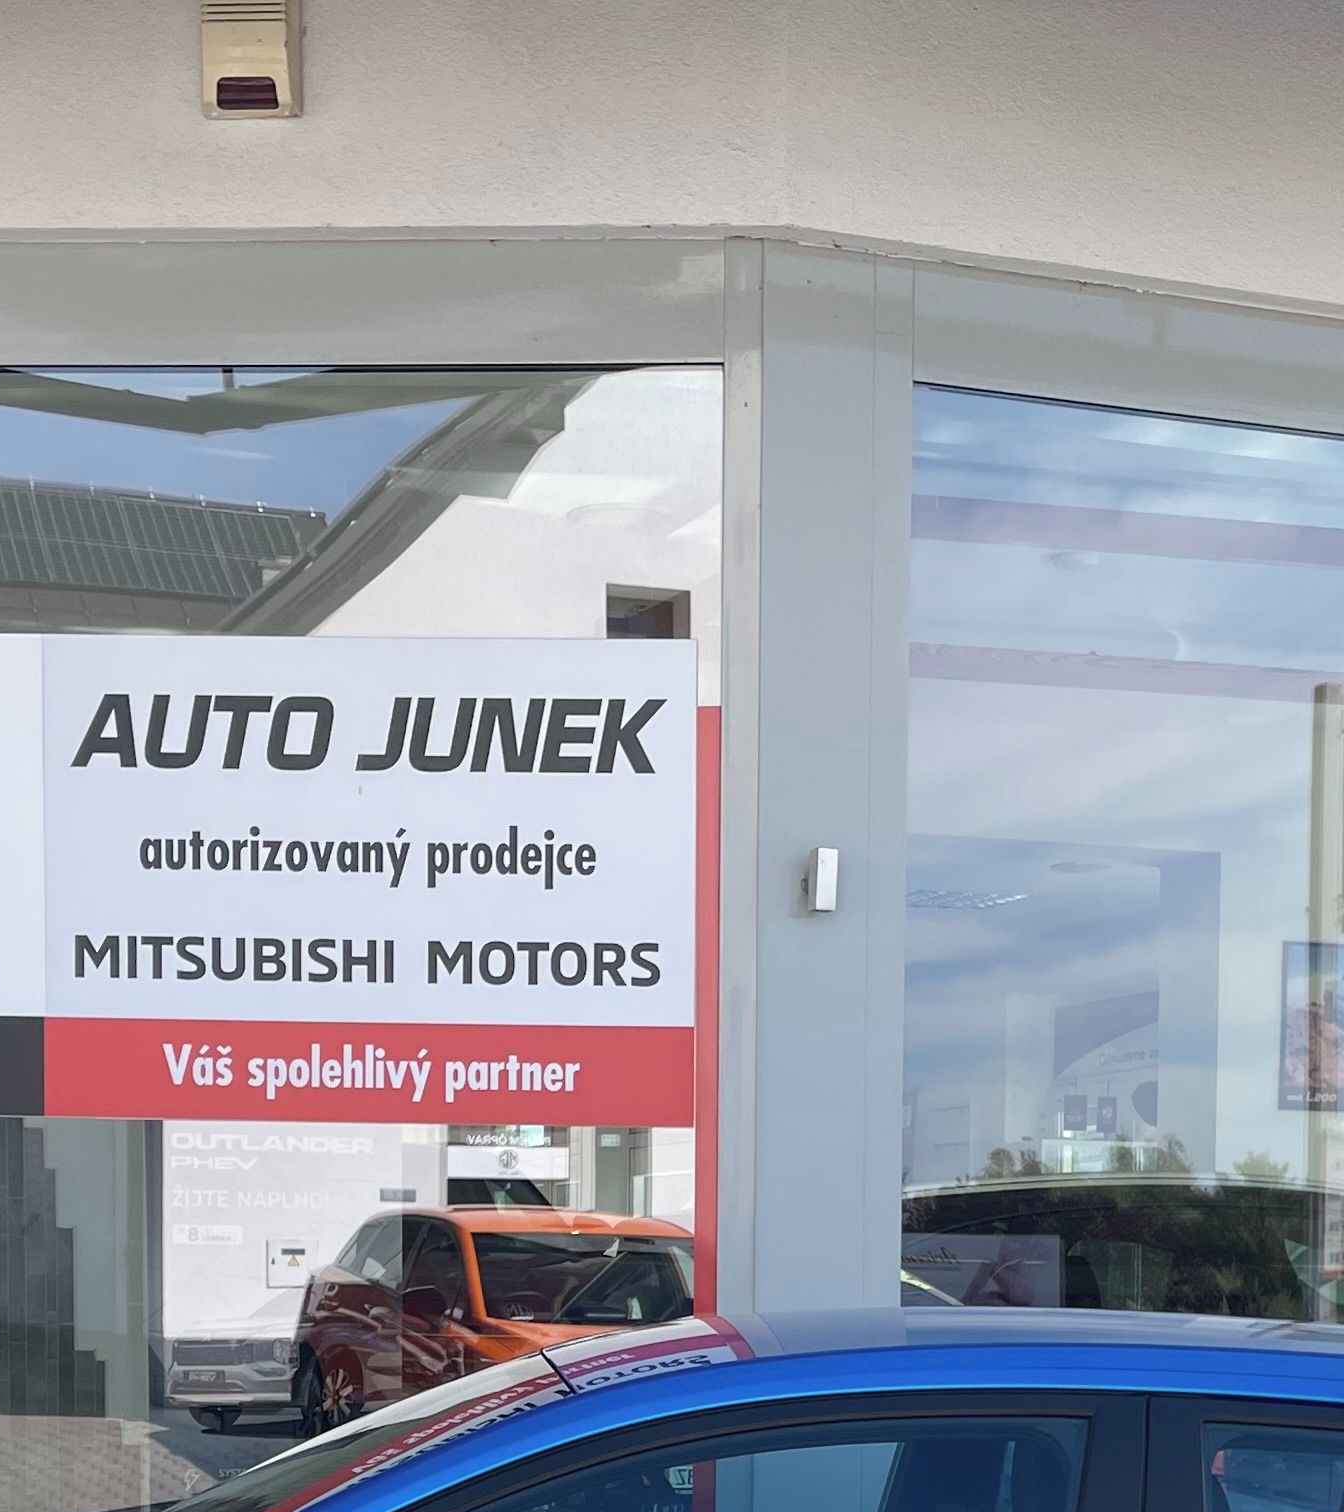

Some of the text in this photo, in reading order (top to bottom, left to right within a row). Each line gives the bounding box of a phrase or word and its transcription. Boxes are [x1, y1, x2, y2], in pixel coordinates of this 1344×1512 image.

[70, 693, 667, 775] AUTO JUNEK
[139, 826, 597, 889] autorizovaný prodejce
[75, 934, 661, 987] MITSUBISHI MOTORS
[163, 1043, 581, 1102] Váš spolehlivý partner
[170, 1132, 375, 1154] OUTLANDER
[170, 1156, 258, 1171] PHEV
